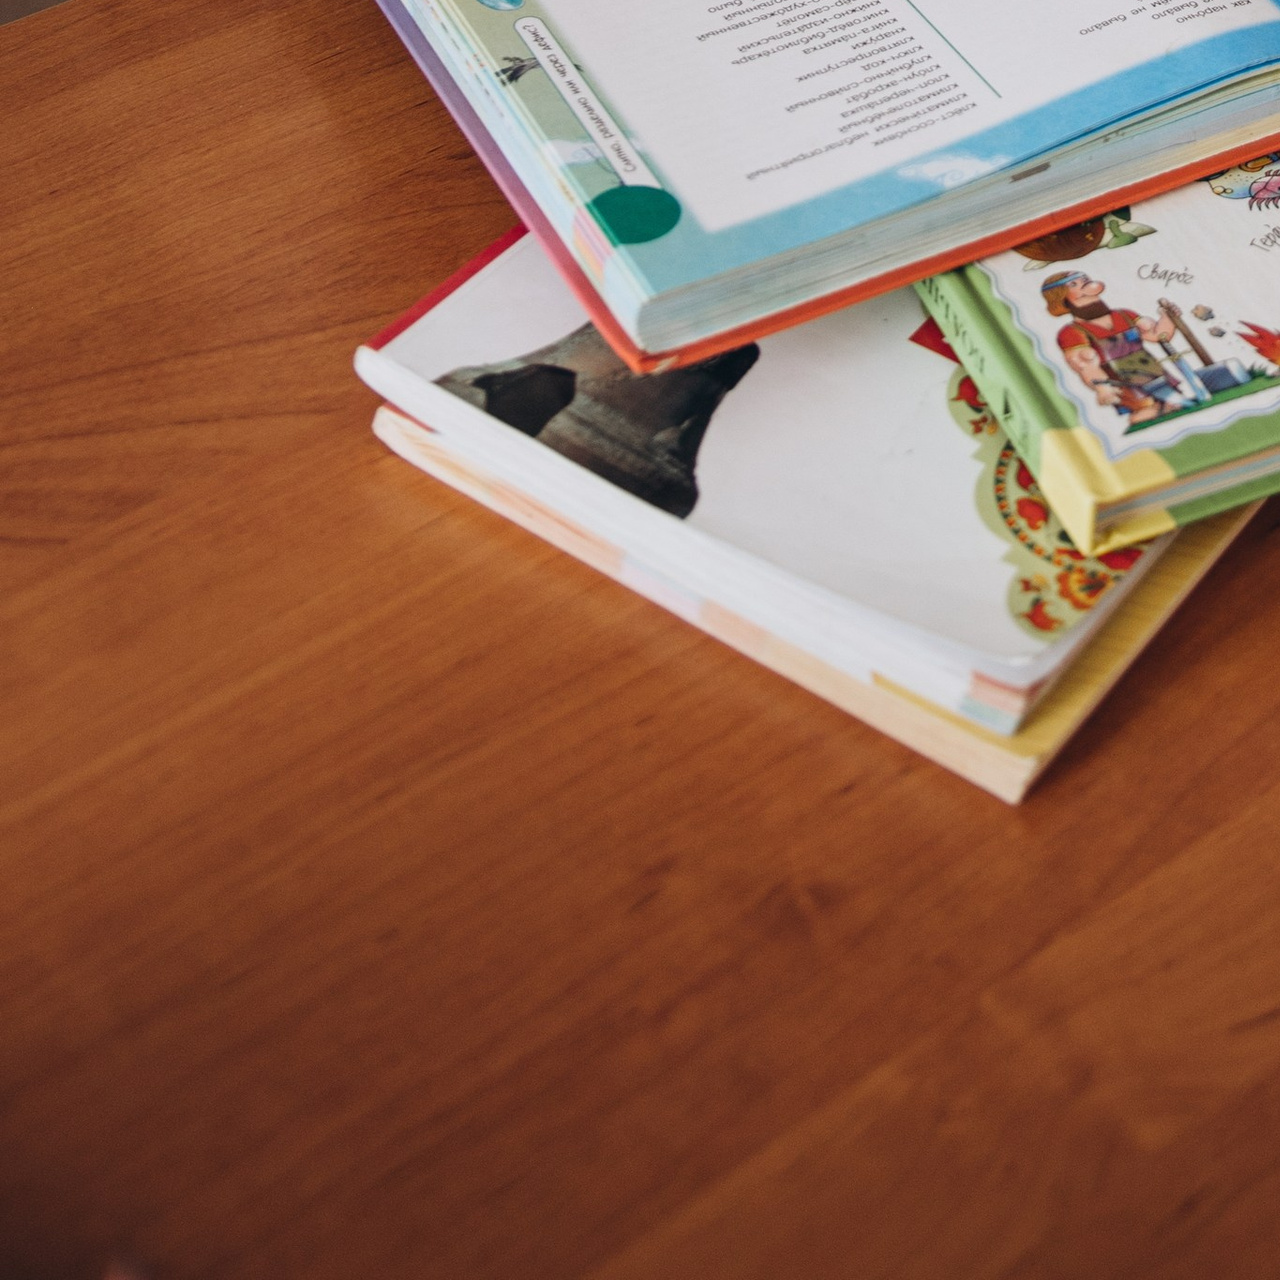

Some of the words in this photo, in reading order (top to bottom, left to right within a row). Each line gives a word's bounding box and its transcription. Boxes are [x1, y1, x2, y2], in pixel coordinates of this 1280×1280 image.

[1129, 5, 1147, 15] не
[1150, 0, 1198, 19] быва́ло
[1175, 4, 1228, 23] наро́чно
[1079, 13, 1127, 35] быва́ло
[522, 24, 553, 51] дефис?
[547, 54, 568, 78] через
[564, 80, 580, 95] или
[577, 97, 614, 139] раздельно
[611, 140, 637, 173] Слитно,
